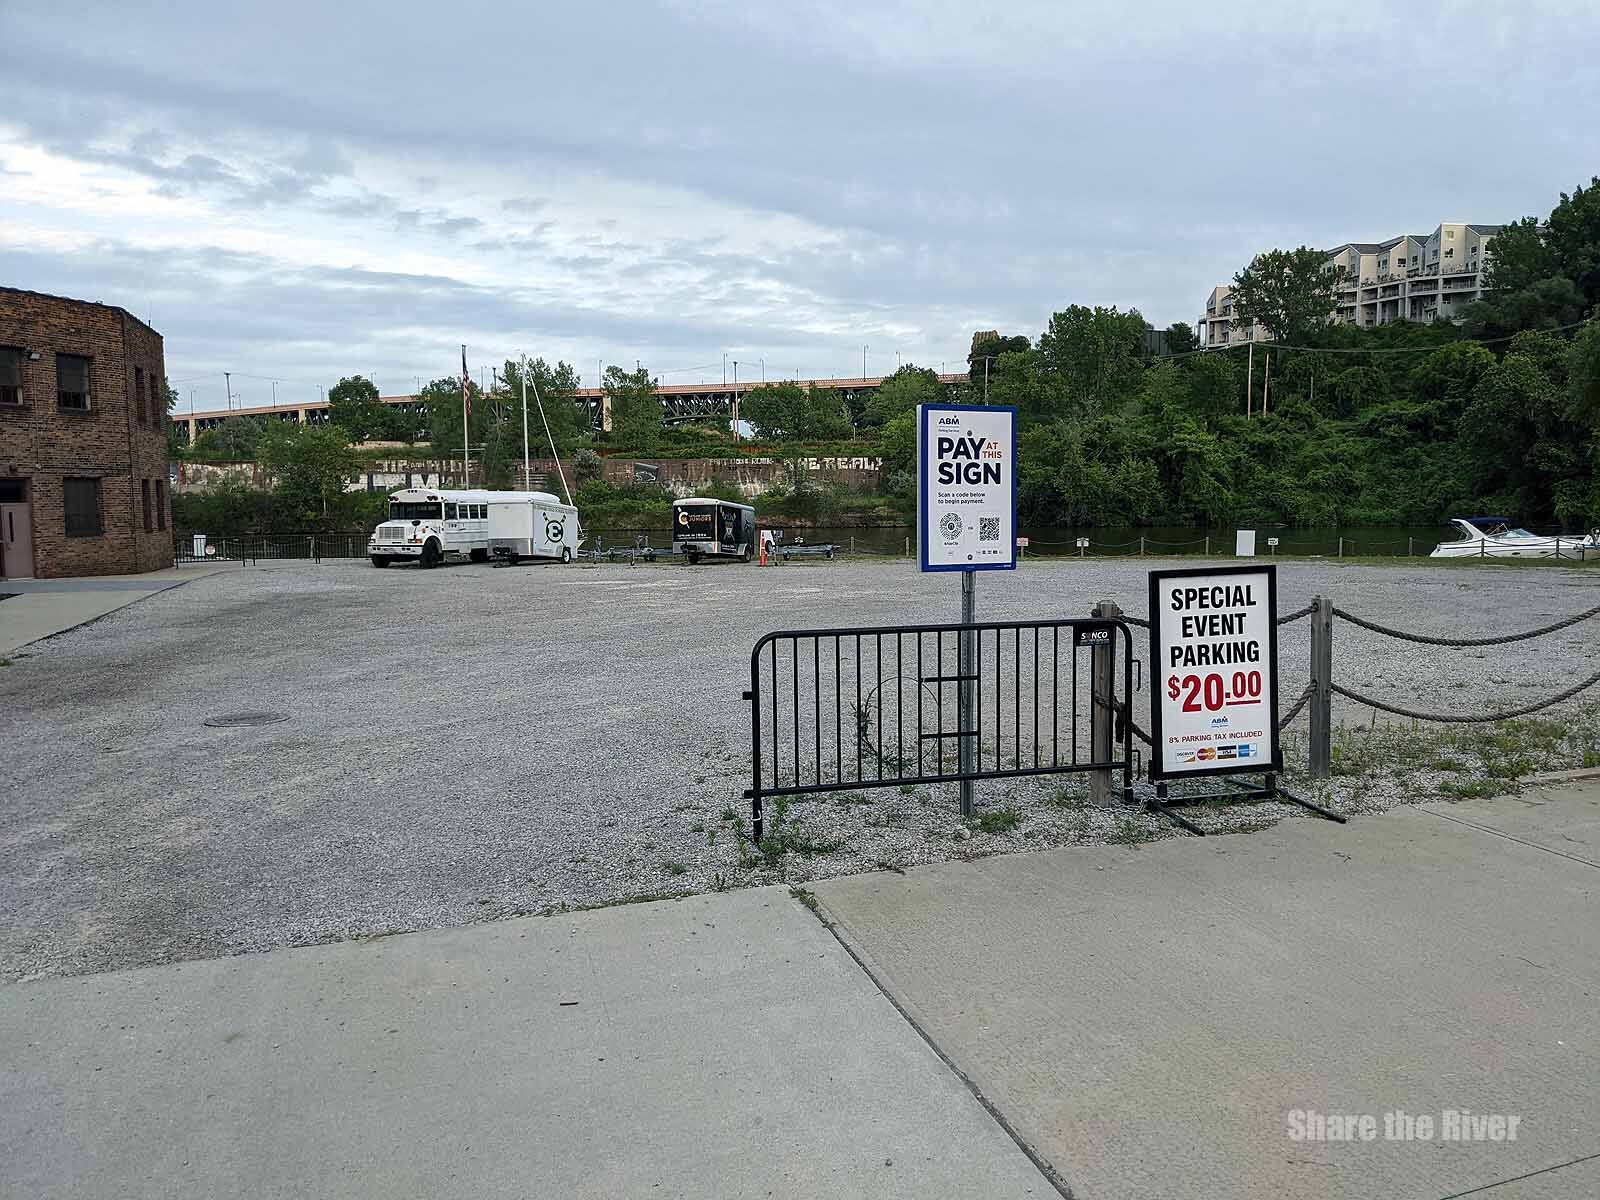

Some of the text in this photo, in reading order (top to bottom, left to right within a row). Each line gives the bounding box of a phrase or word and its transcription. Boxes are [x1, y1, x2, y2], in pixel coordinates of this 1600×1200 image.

[938, 415, 960, 425] ABM
[937, 437, 986, 460] PAY
[982, 451, 1002, 459] THIS
[986, 442, 998, 450] AT
[937, 461, 1001, 485] SIGN
[1171, 585, 1256, 611] SPECIAL
[1182, 613, 1246, 638] EVENT
[1170, 641, 1259, 668] PARKING
[1167, 671, 1261, 712] $20.00
[1181, 735, 1212, 743] PARKING
[1214, 733, 1227, 741] TAX
[1228, 730, 1263, 739] INCLUDED
